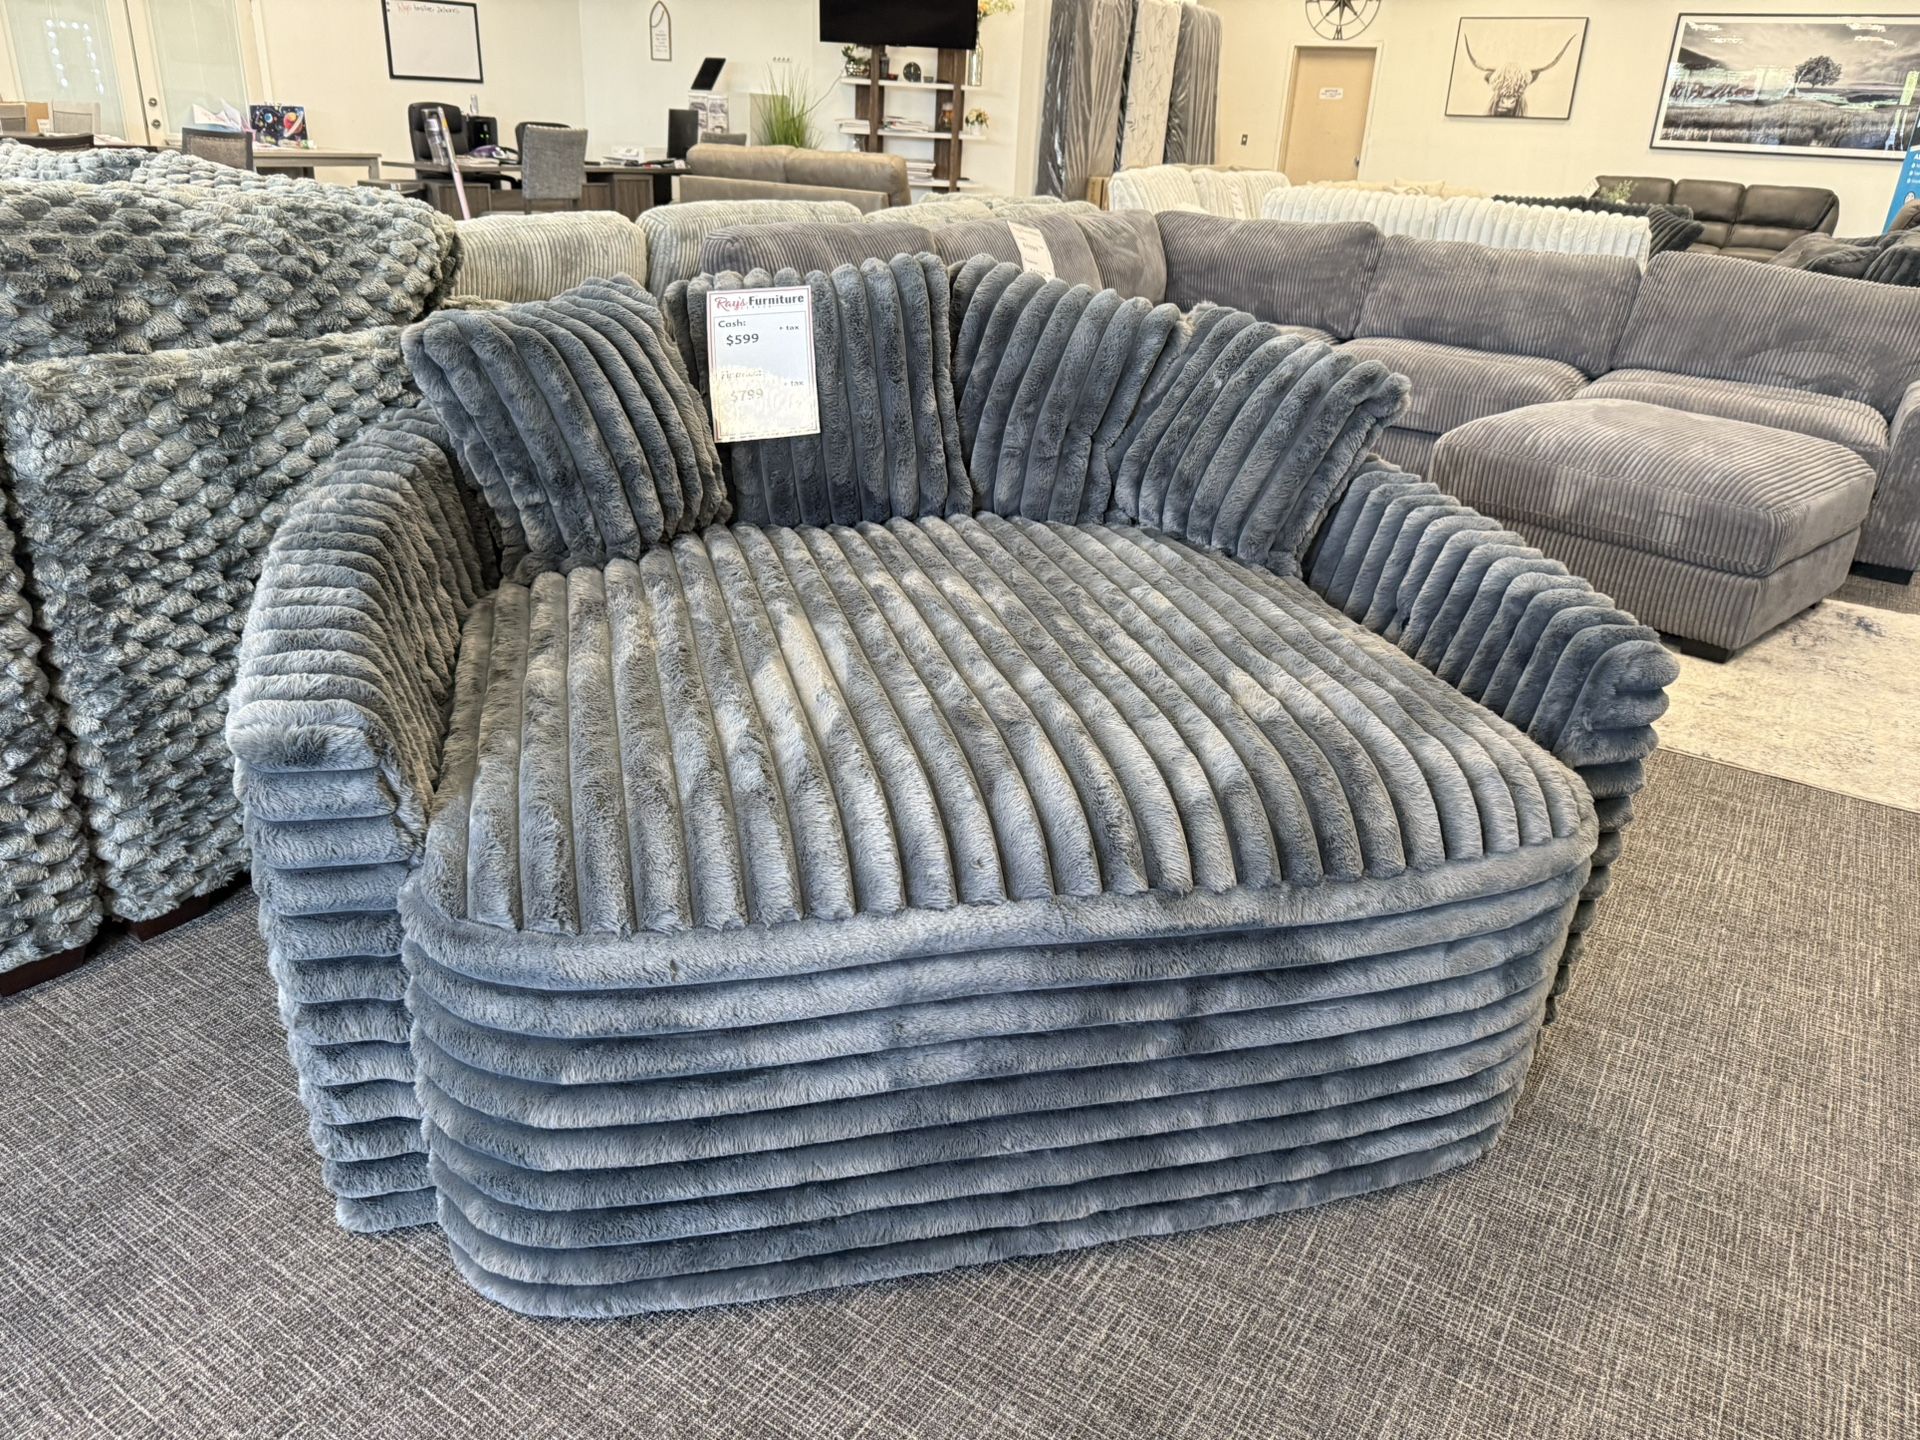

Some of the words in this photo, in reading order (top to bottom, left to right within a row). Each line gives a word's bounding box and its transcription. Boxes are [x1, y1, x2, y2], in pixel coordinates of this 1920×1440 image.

[715, 296, 746, 312] Ray's
[748, 294, 805, 306] Furniture
[718, 319, 747, 329] Cash:
[726, 333, 760, 347] $599
[730, 388, 764, 403] $799
